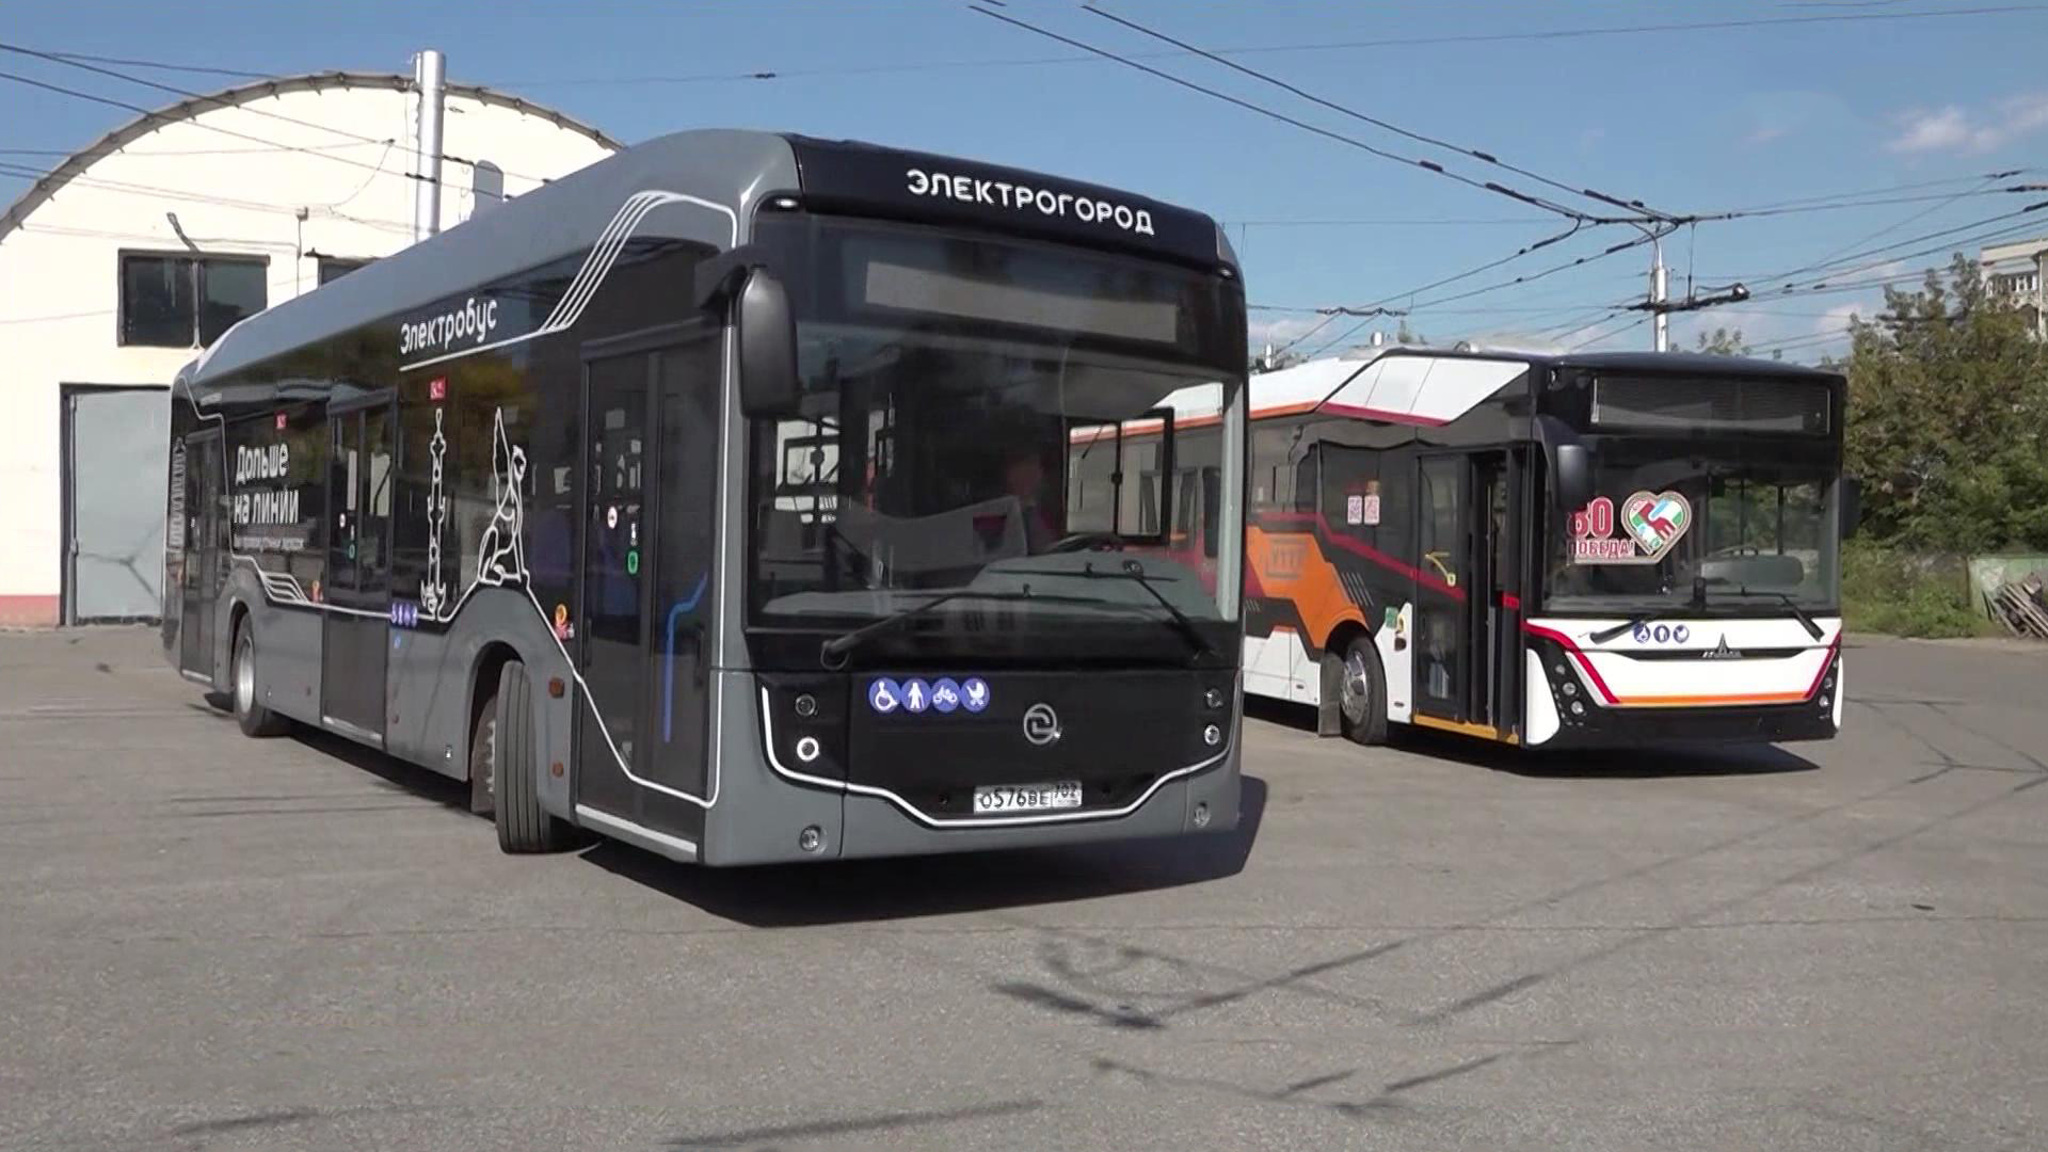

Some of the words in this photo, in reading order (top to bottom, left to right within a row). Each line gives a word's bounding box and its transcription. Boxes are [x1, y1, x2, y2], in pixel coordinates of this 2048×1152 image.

[906, 168, 1154, 236] ЭЛЕКТРОГОРОД
[400, 297, 497, 355] Электробус
[235, 443, 289, 486] Дольше
[234, 493, 250, 524] на
